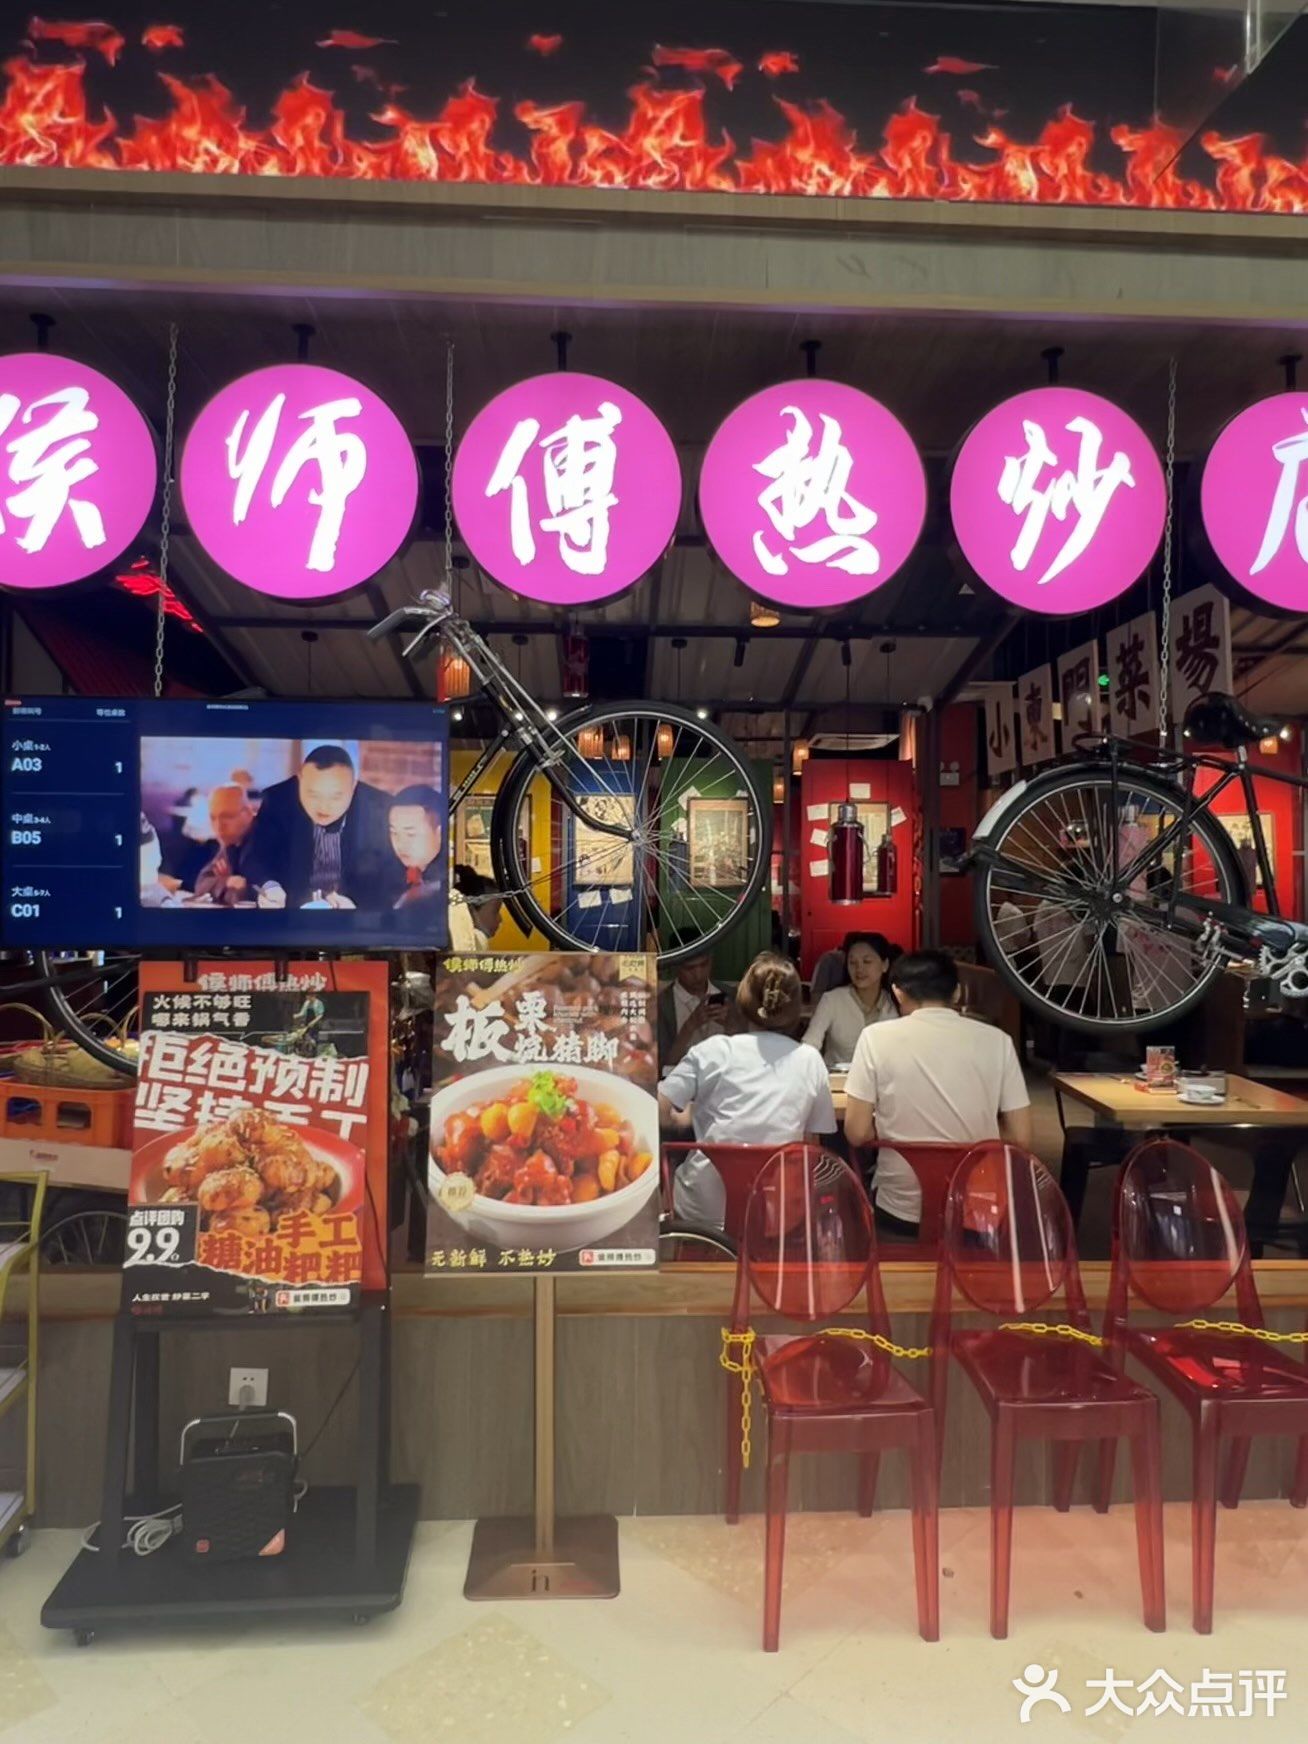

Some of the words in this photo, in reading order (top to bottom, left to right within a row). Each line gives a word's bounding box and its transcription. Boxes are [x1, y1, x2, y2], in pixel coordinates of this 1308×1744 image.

[12, 758, 42, 771] A03
[115, 761, 123, 773] 1
[11, 831, 41, 844] B05
[115, 834, 123, 846] 1
[11, 904, 40, 917] C01
[115, 907, 123, 919] 1
[153, 994, 251, 1010] 火候不够旺
[138, 1032, 369, 1108] 拒绝预制
[129, 1209, 185, 1227] 点评团购
[276, 1209, 358, 1248] 手工
[200, 1231, 361, 1283] 糖油粑粑
[498, 1248, 557, 1267] 不热炒
